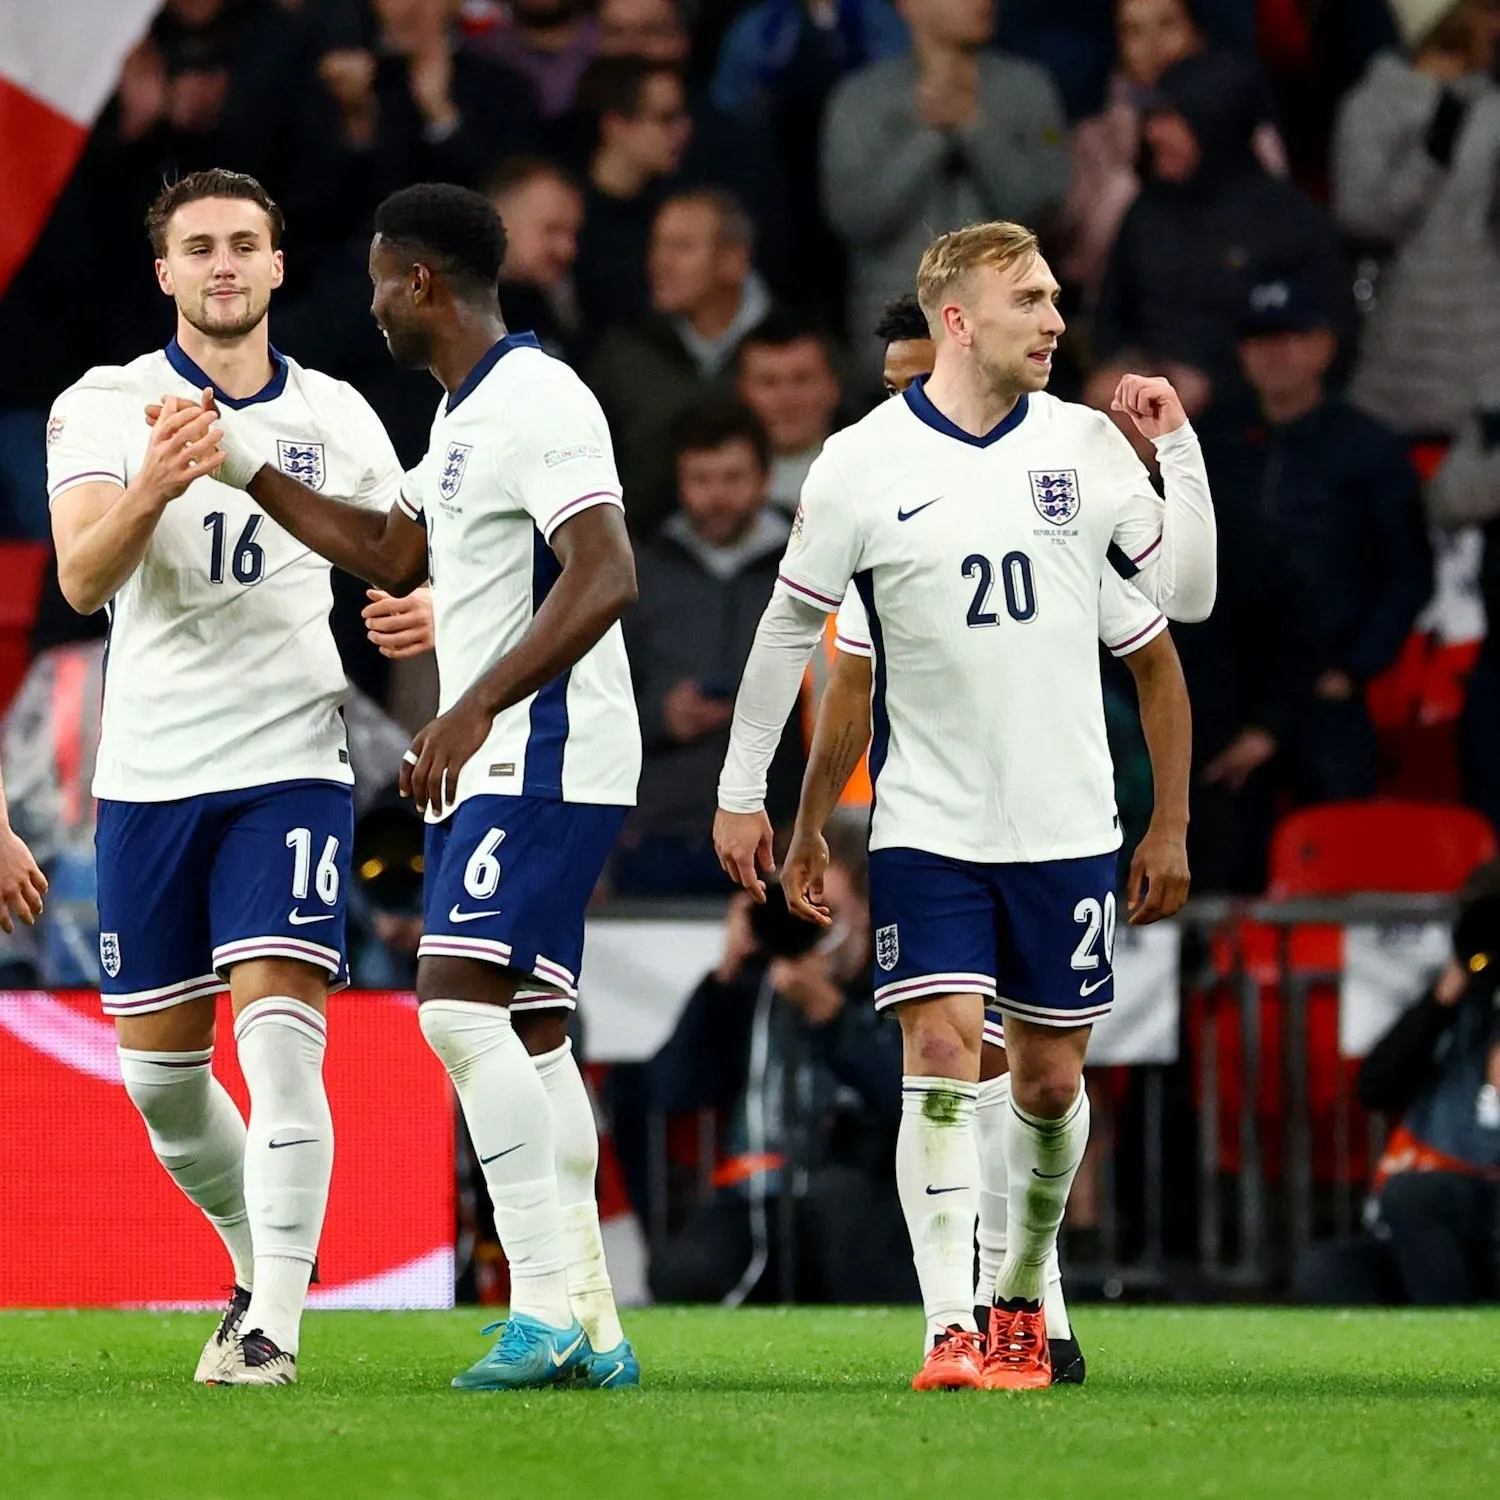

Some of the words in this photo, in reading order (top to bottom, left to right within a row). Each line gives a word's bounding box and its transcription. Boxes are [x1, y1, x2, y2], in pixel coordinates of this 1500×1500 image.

[203, 511, 265, 586] 16
[961, 551, 1038, 628] 20
[285, 826, 339, 905] 16
[464, 826, 506, 900] 6
[1070, 891, 1116, 970] 20
